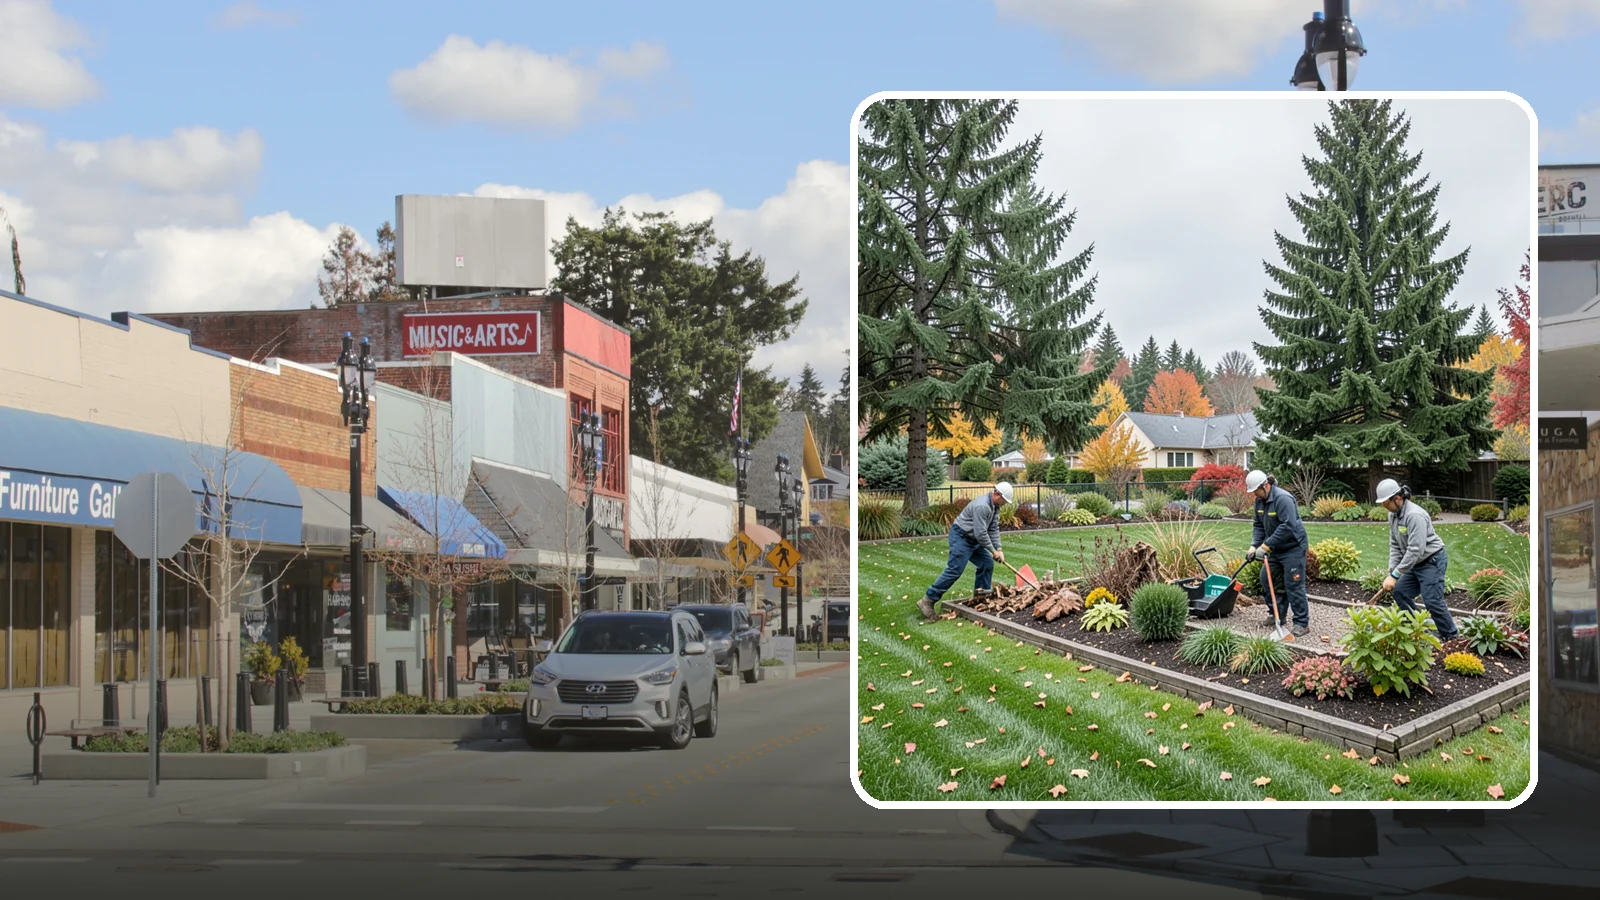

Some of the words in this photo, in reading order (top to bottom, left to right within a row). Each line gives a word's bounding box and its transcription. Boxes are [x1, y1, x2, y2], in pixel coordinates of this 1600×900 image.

[409, 322, 519, 349] MUSIC&ARTS
[1540, 428, 1577, 436] UGA
[0, 471, 79, 515] Furniture
[89, 482, 122, 519] Gal
[453, 563, 479, 575] SUSHI
